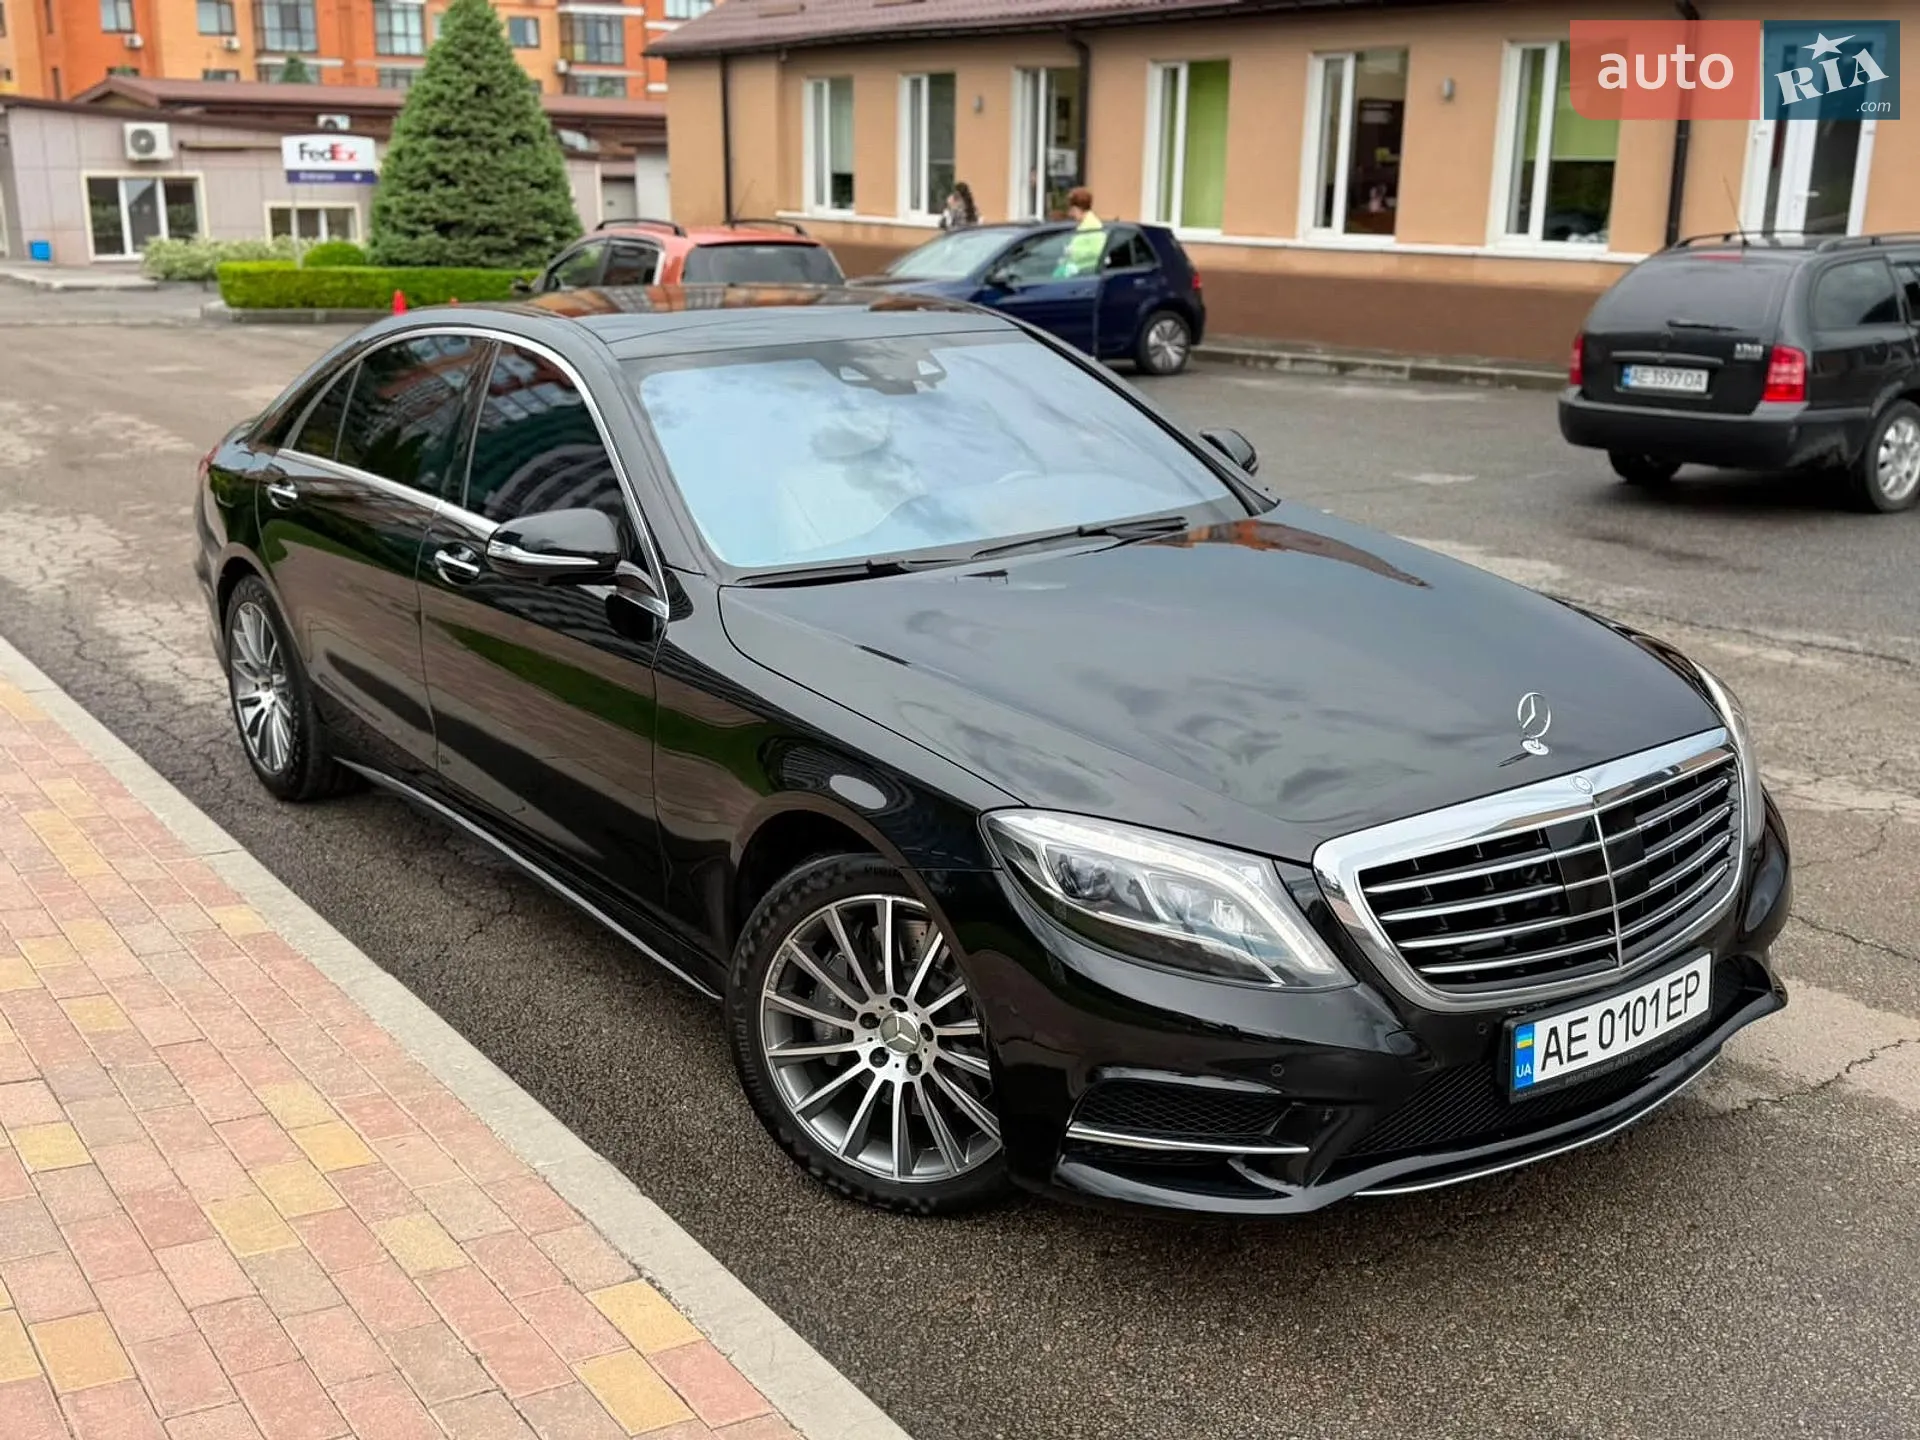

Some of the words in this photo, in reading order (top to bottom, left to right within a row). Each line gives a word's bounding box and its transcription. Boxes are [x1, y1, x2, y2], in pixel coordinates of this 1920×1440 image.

[299, 143, 357, 161] FedEx
[1540, 1016, 1589, 1072] AE
[1599, 987, 1660, 1050] 0101
[1666, 969, 1700, 1022] EP
[1516, 1065, 1532, 1078] UA
